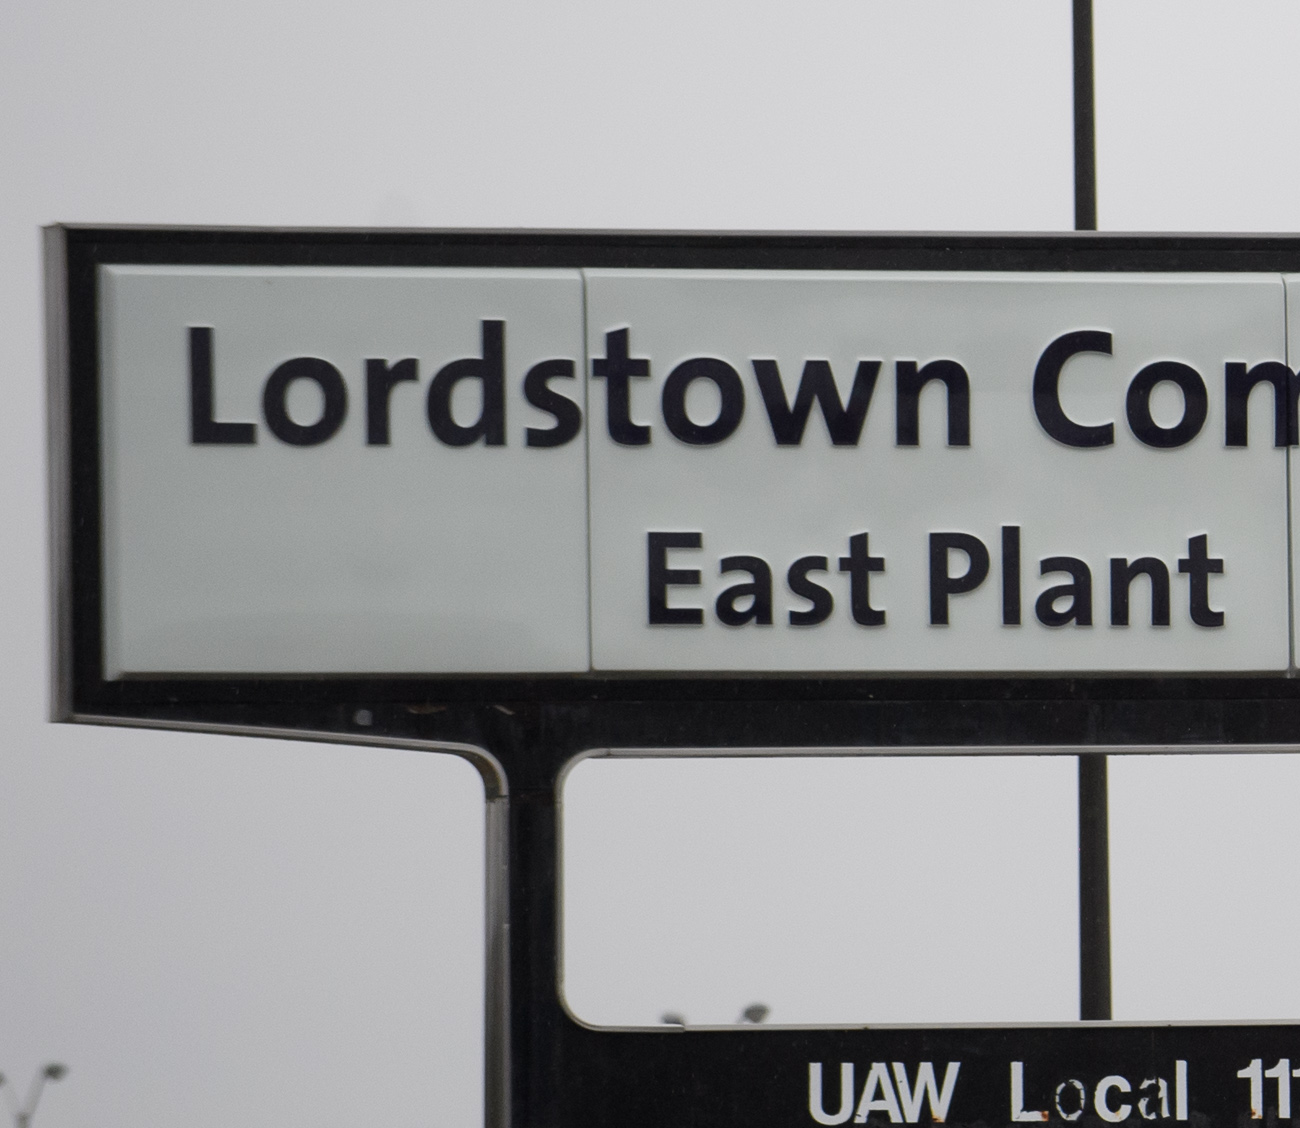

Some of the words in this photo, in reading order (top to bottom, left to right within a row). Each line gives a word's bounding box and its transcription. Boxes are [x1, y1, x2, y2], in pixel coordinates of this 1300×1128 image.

[190, 320, 970, 448] Lordstown
[648, 532, 885, 626] East
[930, 526, 1224, 627] Plant
[808, 1061, 961, 1125] UAW
[1010, 1060, 1188, 1123] Local
